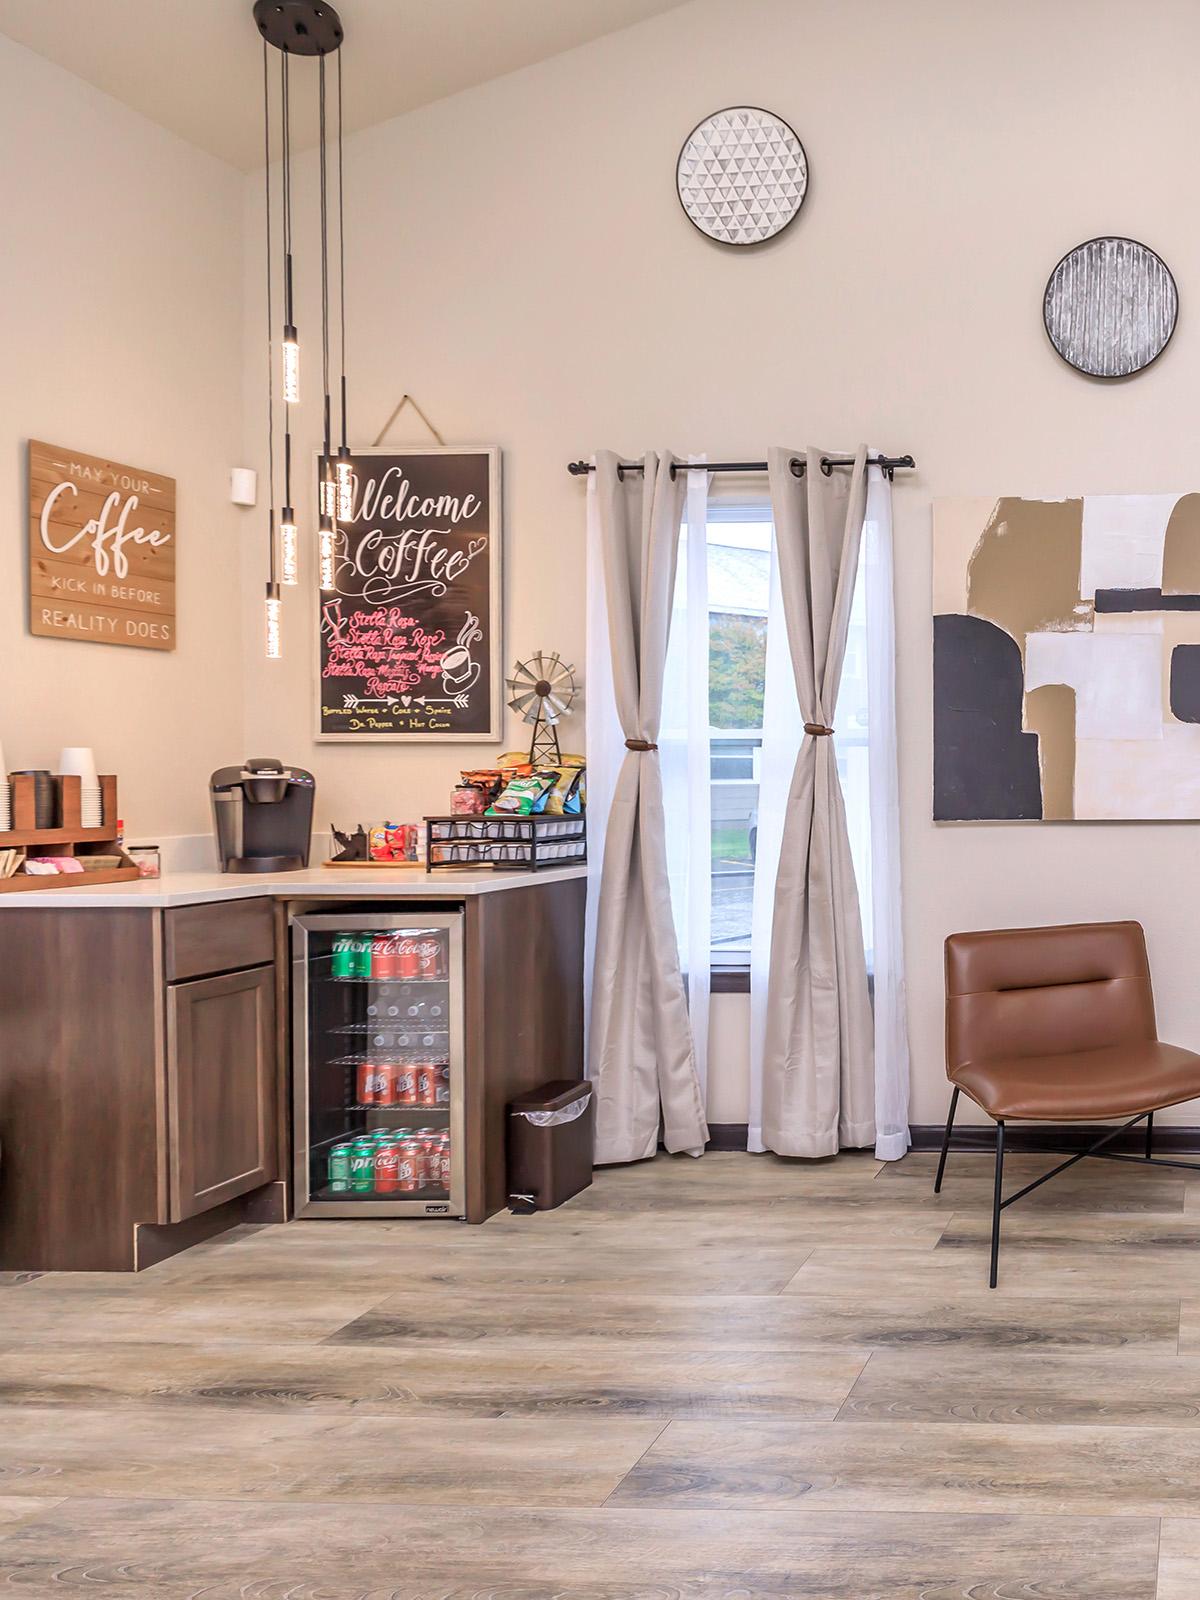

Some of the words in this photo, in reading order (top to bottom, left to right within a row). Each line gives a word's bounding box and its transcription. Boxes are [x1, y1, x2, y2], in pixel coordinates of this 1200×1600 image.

[69, 461, 103, 482] MAY
[111, 473, 150, 495] YOUR
[350, 467, 481, 523] Welcome
[40, 481, 171, 580] Coffee
[51, 576, 88, 593] KICK
[92, 583, 106, 596] IN
[111, 585, 161, 605] BEFORE
[41, 608, 119, 633] REALITY
[126, 620, 170, 641] DOES
